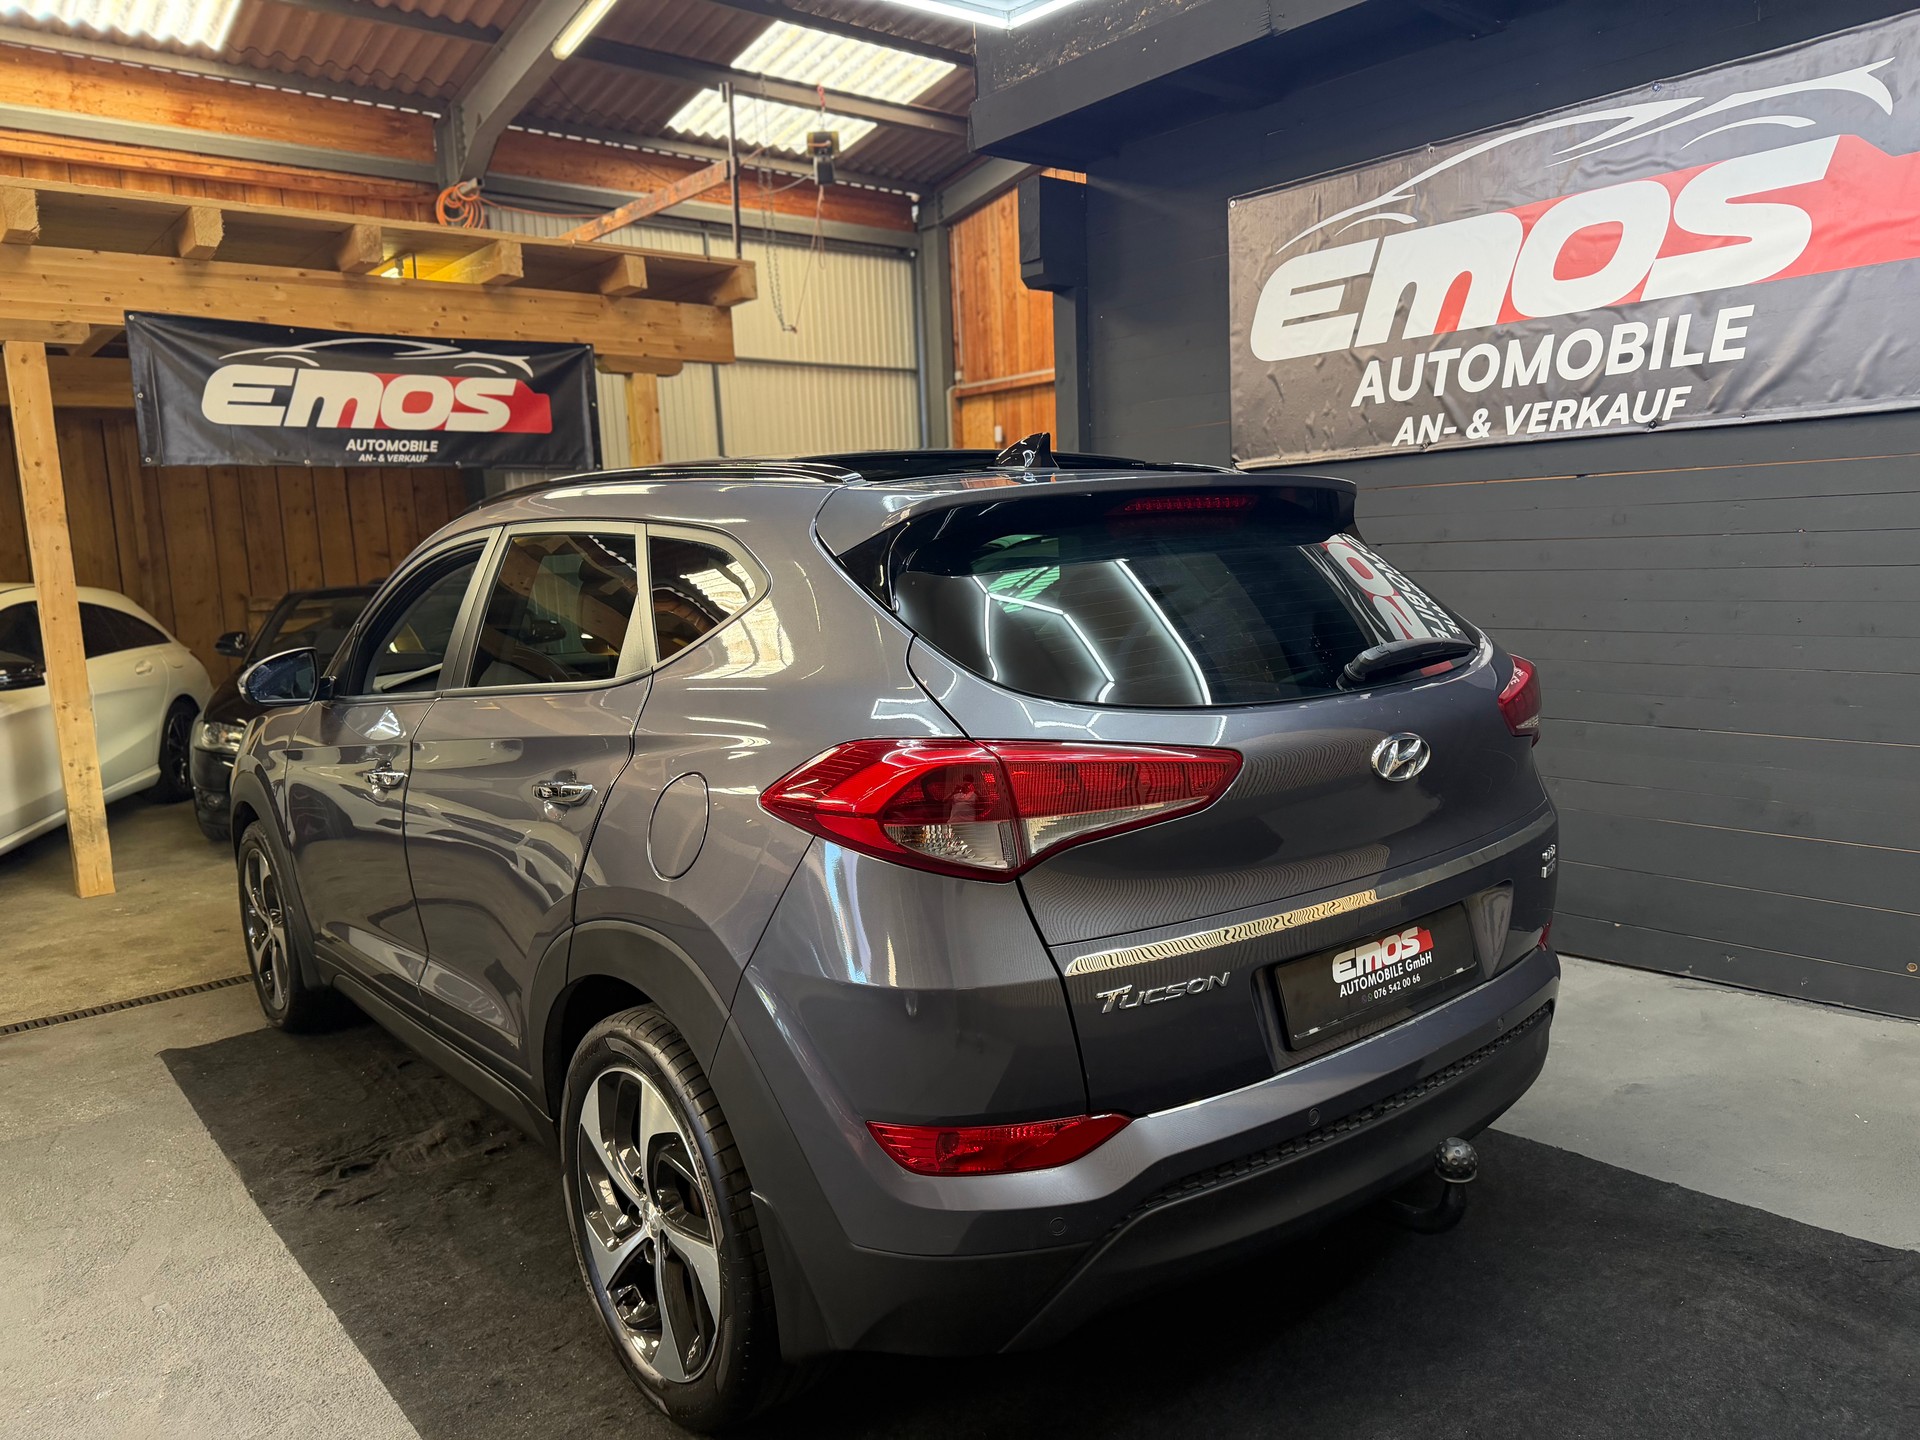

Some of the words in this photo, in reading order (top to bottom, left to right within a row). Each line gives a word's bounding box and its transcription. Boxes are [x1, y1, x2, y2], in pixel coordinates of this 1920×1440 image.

[1250, 134, 1840, 362] EMOS
[1350, 303, 1755, 408] AUTOMOBILE
[201, 364, 518, 432] EMOS
[1391, 411, 1457, 447] AN-
[1465, 409, 1490, 441] &
[1502, 384, 1692, 435] VERKAUF
[345, 438, 439, 453] AUTOMOBILE
[358, 453, 376, 462] AN-
[378, 454, 385, 463] &
[387, 454, 429, 463] VERKAUF
[1332, 926, 1420, 984] EMOS
[1339, 962, 1404, 998] AUTOMOBILE
[1405, 951, 1433, 972] GmbH
[1095, 971, 1231, 1014] TUCSON
[1373, 986, 1387, 999] 076
[1388, 981, 1402, 994] 542
[1402, 977, 1411, 988] 00
[1412, 973, 1421, 984] 66
